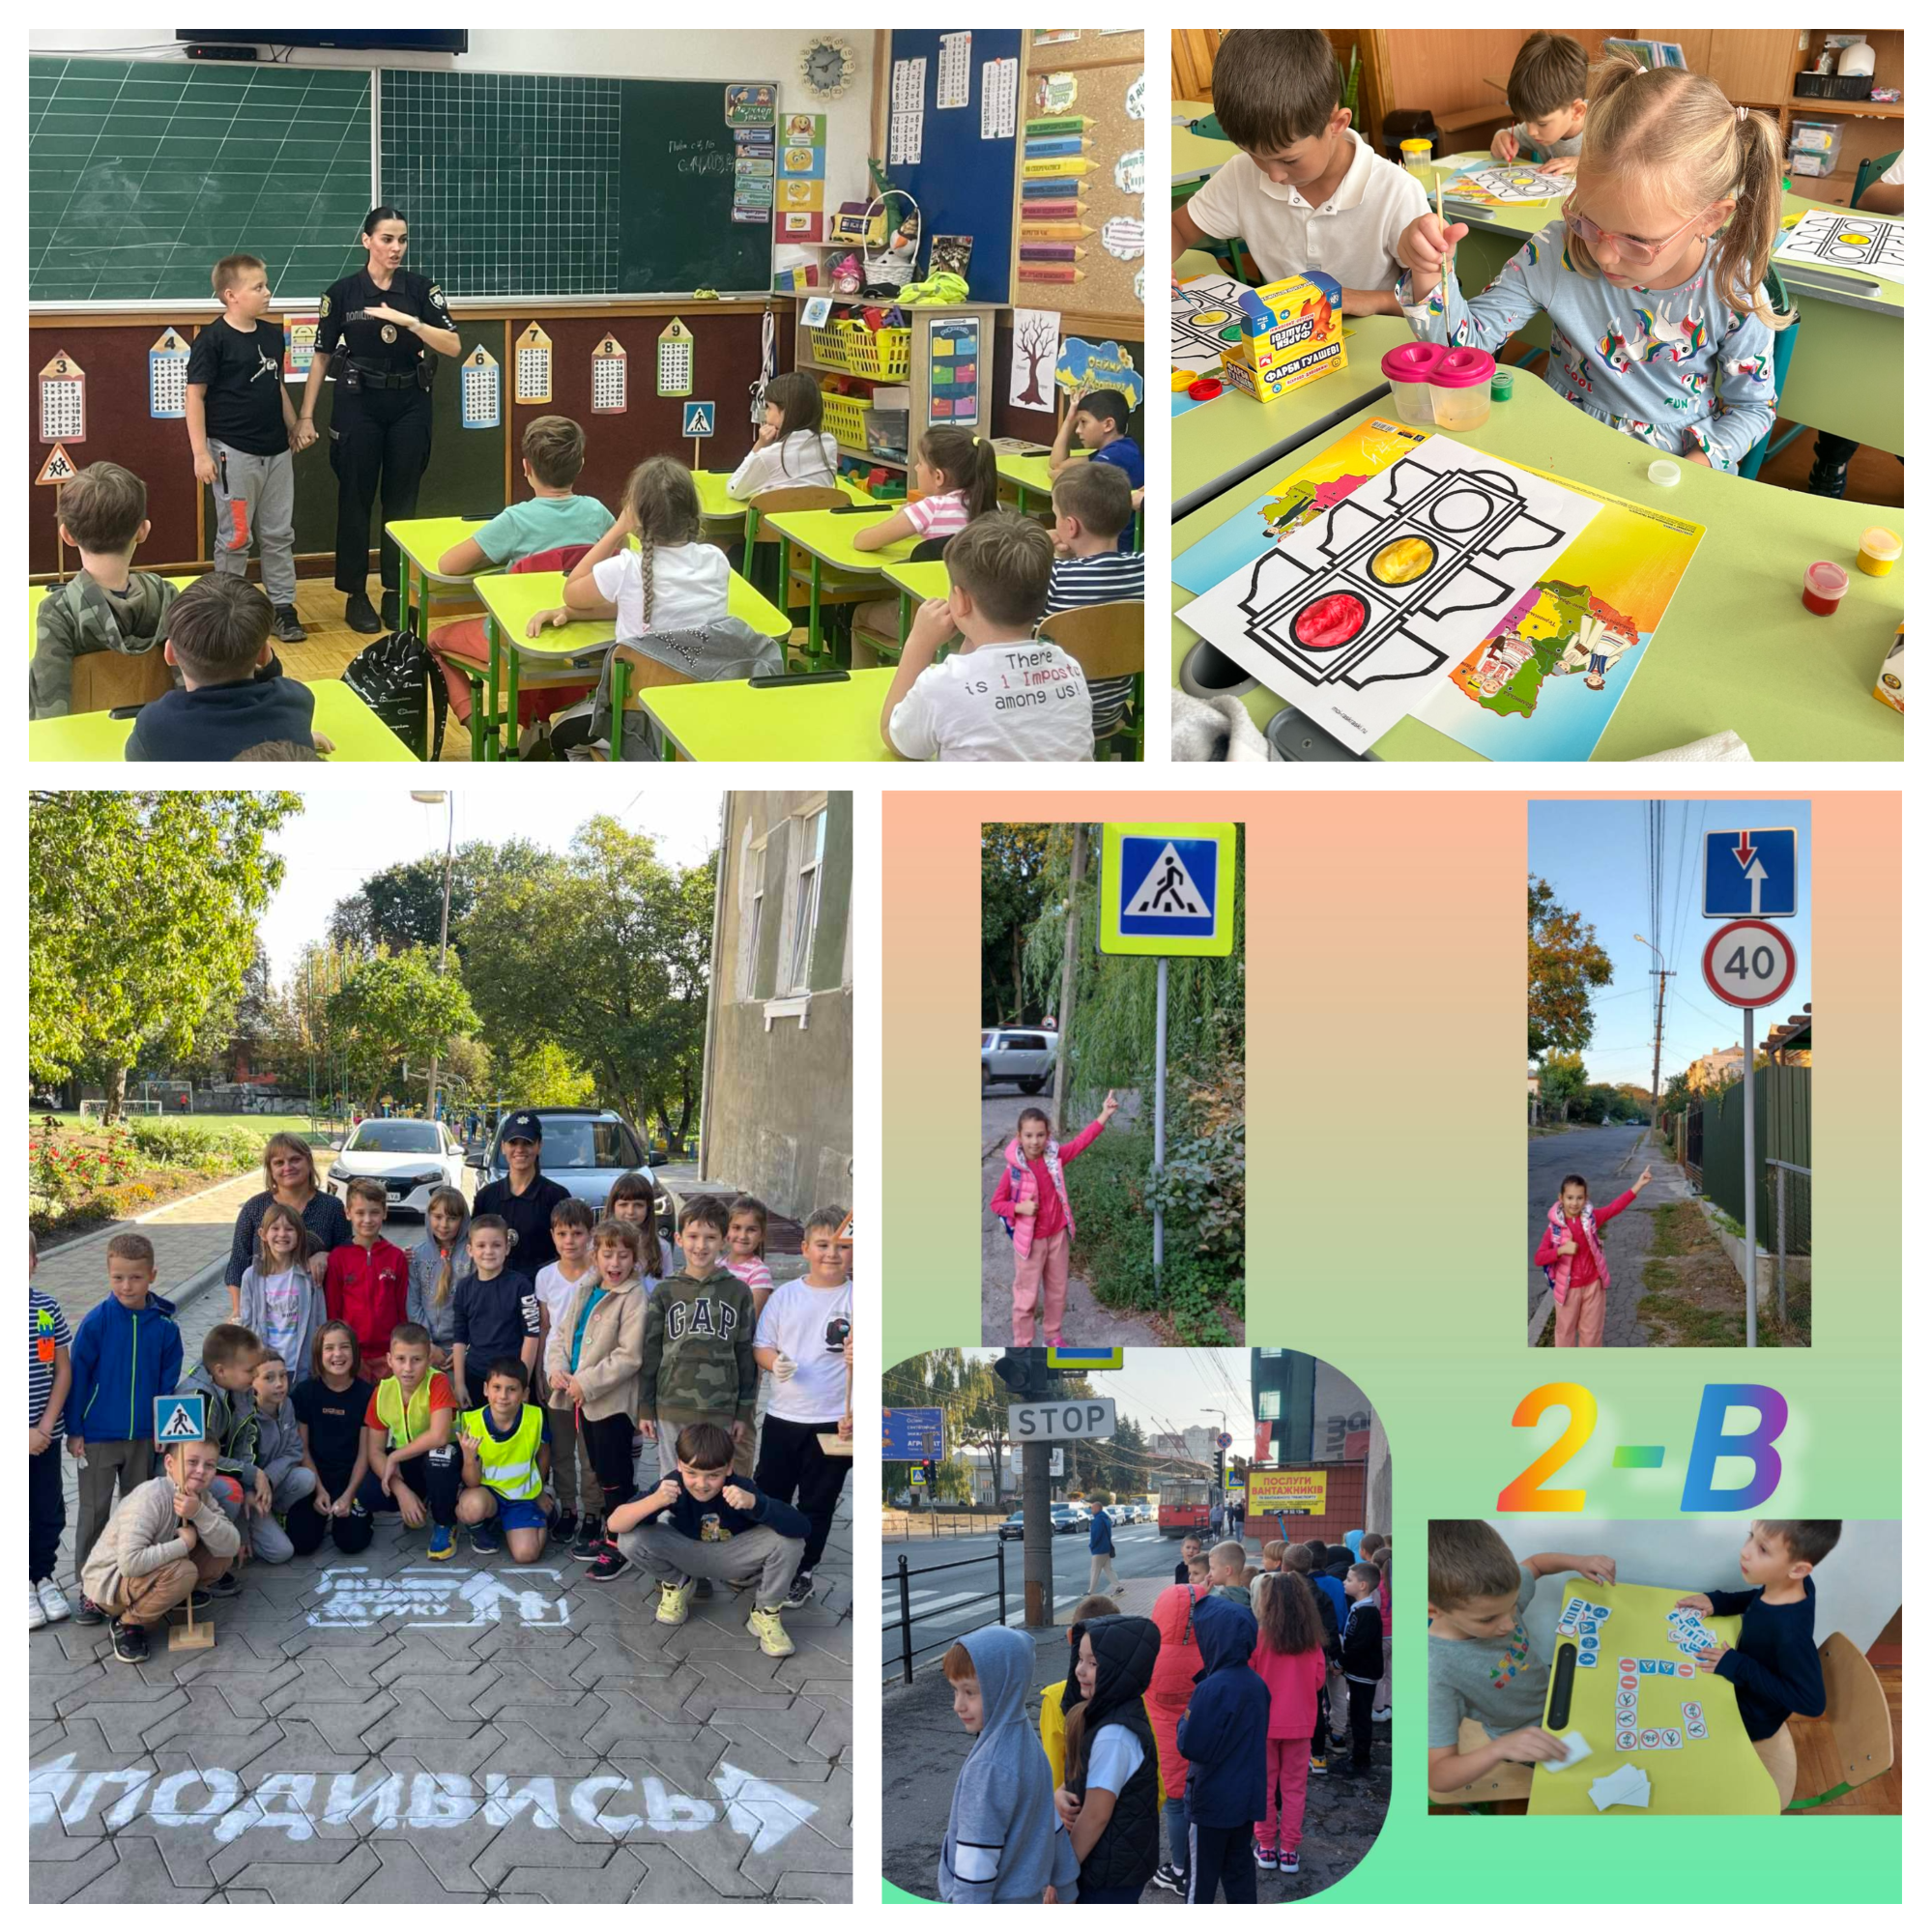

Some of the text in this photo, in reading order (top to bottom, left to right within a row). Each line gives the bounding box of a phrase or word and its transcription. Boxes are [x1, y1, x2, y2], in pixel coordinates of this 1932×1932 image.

[530, 330, 538, 341] 7
[672, 325, 680, 336] 9
[1271, 321, 1312, 344] ГУАШЕВІ
[1276, 330, 1312, 350] ФАРБИ
[164, 336, 176, 350] 4
[604, 341, 613, 353] 8
[56, 360, 67, 373] 3
[476, 353, 484, 365] 6
[1264, 343, 1340, 382] ФАРБИ ГУАШЕВІ
[1564, 363, 1593, 393] COOL
[1663, 397, 1688, 409] FUN
[1006, 651, 1053, 669] There
[966, 681, 988, 695] is
[1001, 674, 1010, 689] 1
[995, 681, 1081, 710] among us!
[1724, 945, 1774, 980] 40
[668, 1297, 737, 1341] GAP
[1019, 1405, 1105, 1435] STOP
[1252, 1485, 1323, 1495] ВАНТАЖНИКІВ
[1263, 1477, 1312, 1485] ПОСЛУГИ
[63, 1767, 716, 1842] ПОДИВИСЬ
